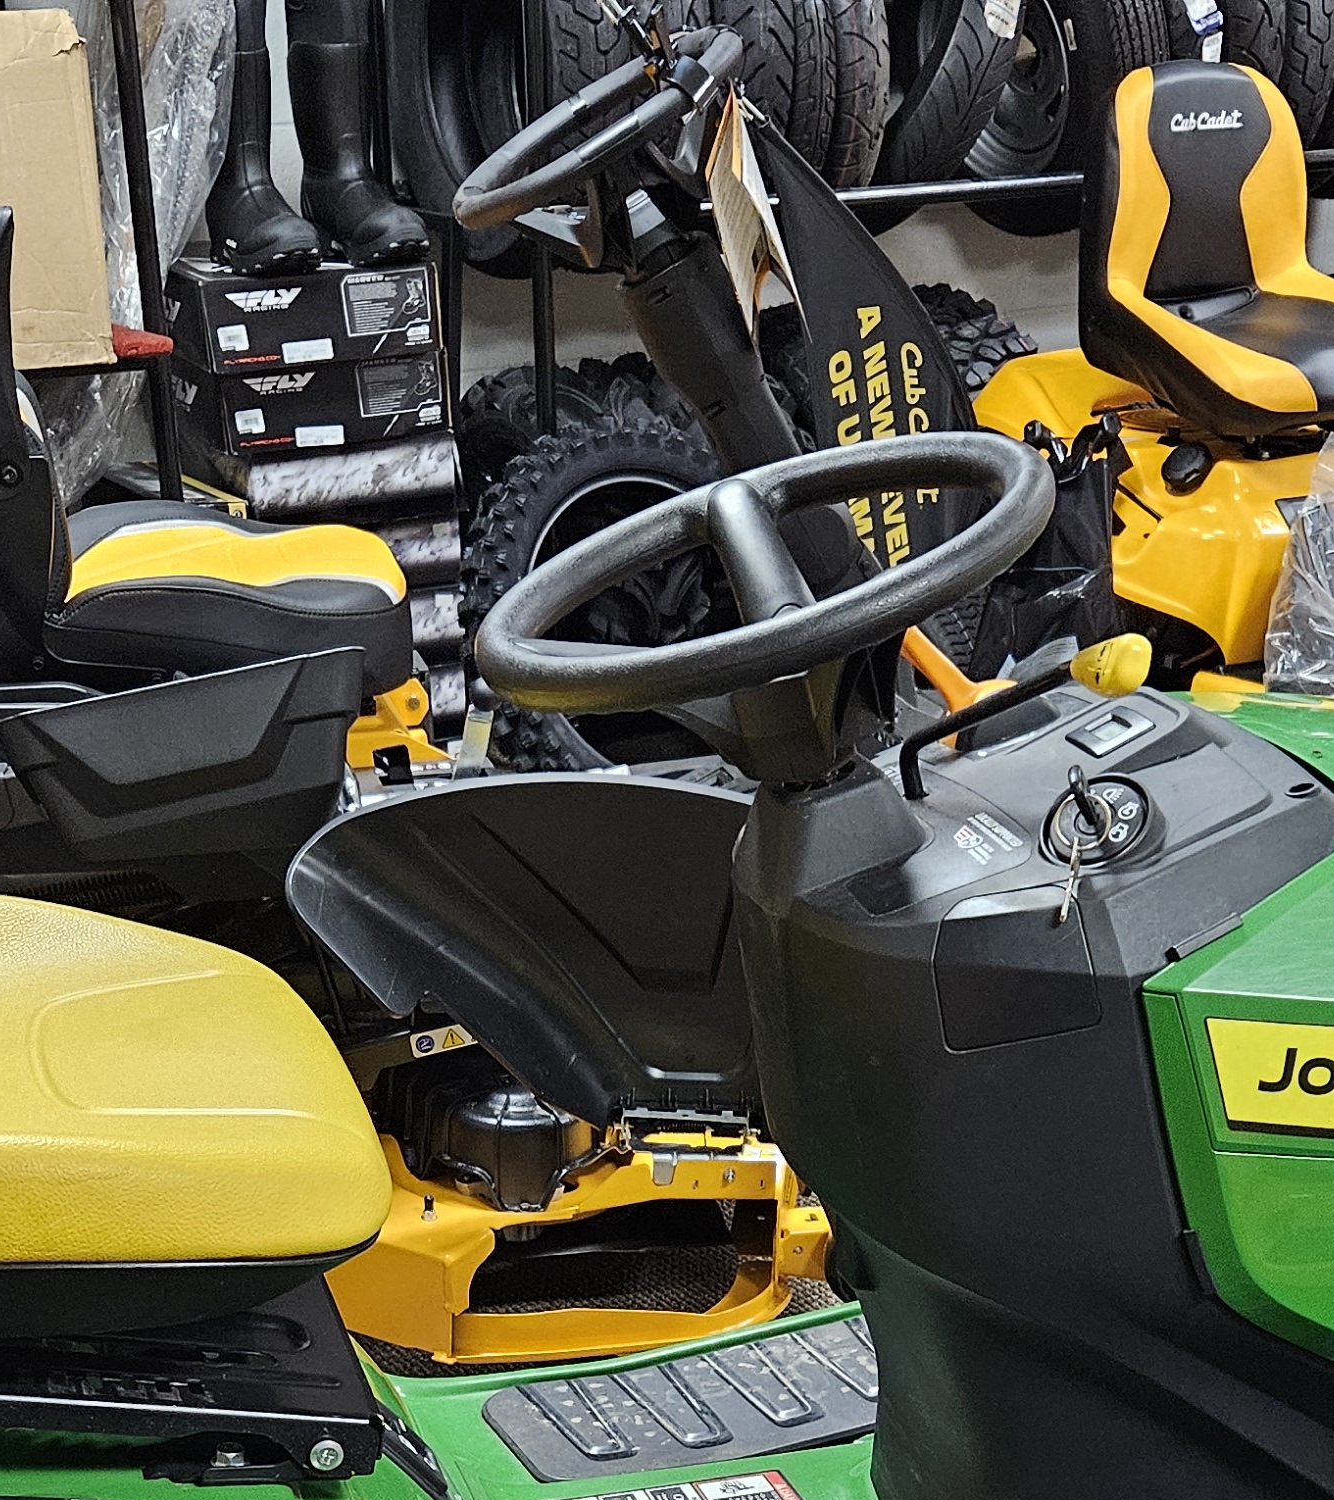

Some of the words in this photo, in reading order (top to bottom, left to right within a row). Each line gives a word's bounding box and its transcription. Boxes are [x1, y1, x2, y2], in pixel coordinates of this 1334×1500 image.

[1170, 113, 1196, 132] Cub
[1197, 109, 1244, 131] Cadet
[225, 287, 302, 309] FLY
[857, 306, 882, 340] A
[242, 371, 316, 392] FLY
[828, 350, 858, 407] OF
[900, 341, 927, 405] Cub
[863, 341, 897, 440] NEW
